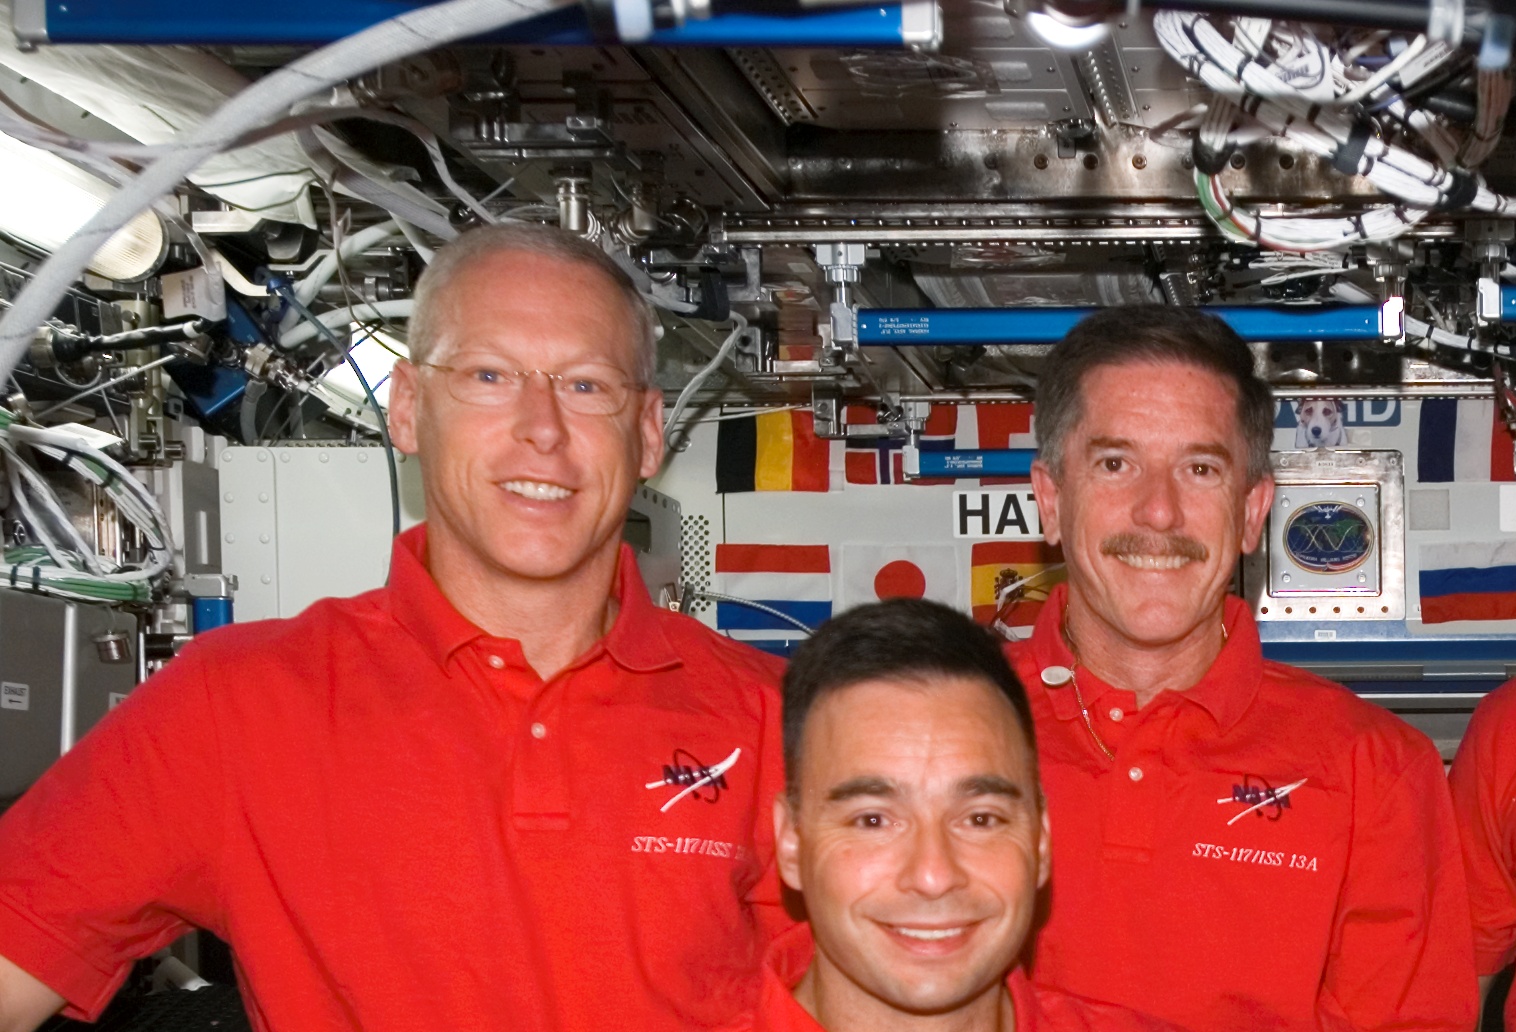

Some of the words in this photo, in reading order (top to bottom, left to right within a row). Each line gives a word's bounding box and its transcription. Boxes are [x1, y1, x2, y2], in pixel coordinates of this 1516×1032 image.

[631, 835, 733, 858] STS-117/ISS
[1192, 842, 1284, 866] STS-117/ISS
[1288, 853, 1318, 871] 13A
